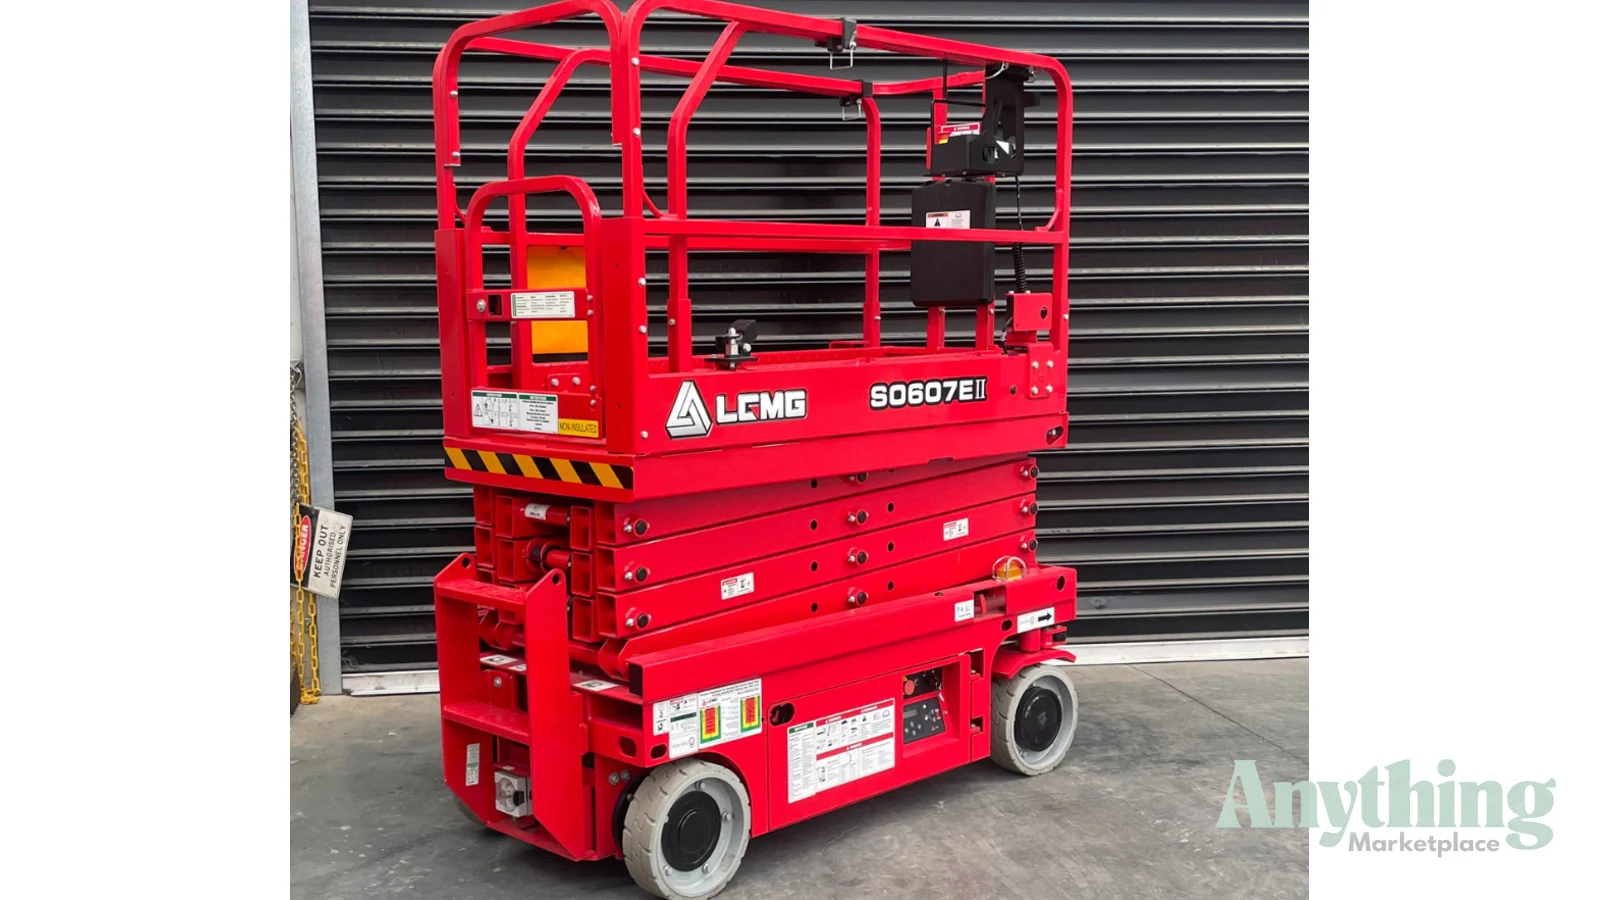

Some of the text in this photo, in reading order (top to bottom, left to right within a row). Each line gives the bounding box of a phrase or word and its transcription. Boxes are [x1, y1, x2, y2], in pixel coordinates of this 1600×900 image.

[559, 421, 598, 434] NON-INSULATED
[715, 389, 806, 424] LGMG
[313, 524, 329, 578] KEEP OUT
[323, 531, 337, 577] AUTHORISED
[330, 524, 347, 588] PERSONNEL ONLY
